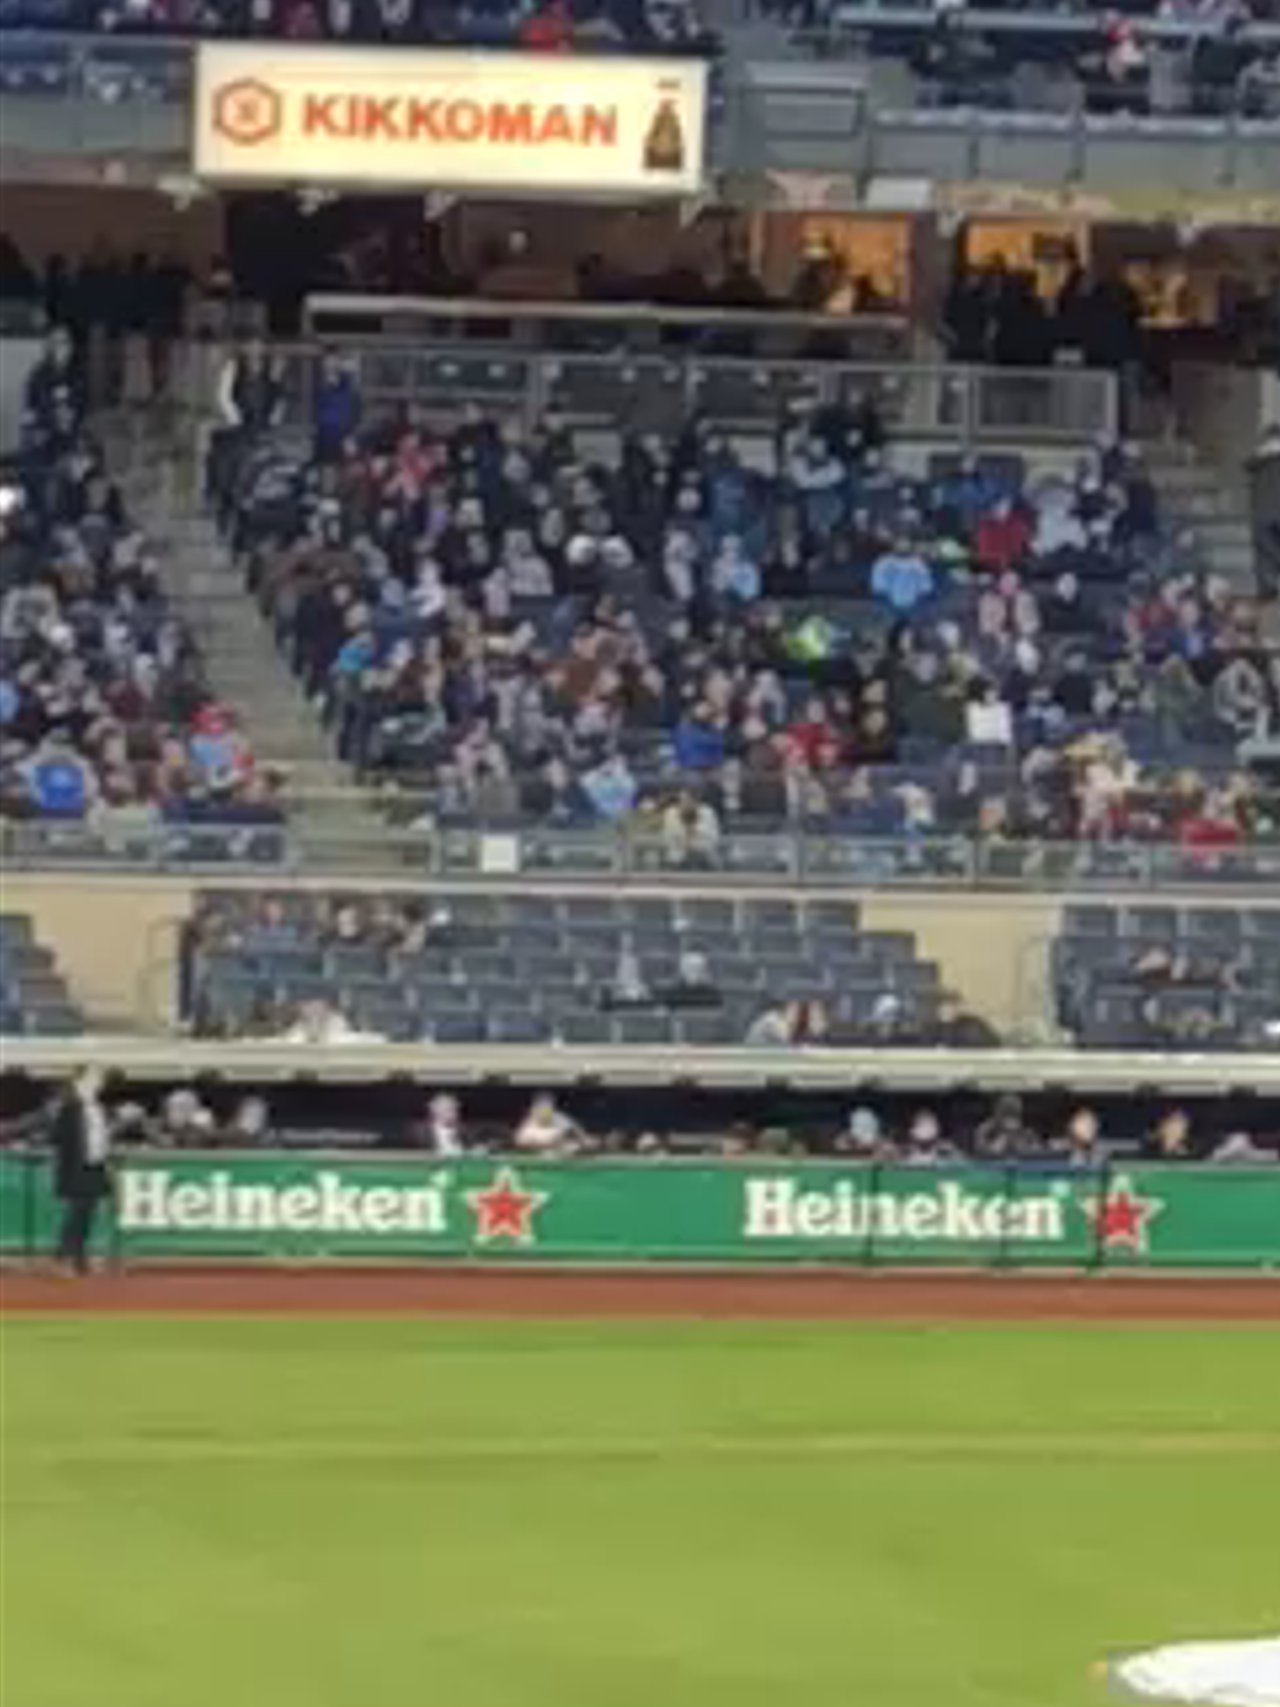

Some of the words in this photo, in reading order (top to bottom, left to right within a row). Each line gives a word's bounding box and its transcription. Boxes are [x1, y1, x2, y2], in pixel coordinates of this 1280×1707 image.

[302, 92, 618, 146] KIKKOMAN
[117, 1169, 446, 1233] Heineken
[744, 1176, 1064, 1239] Heineken
